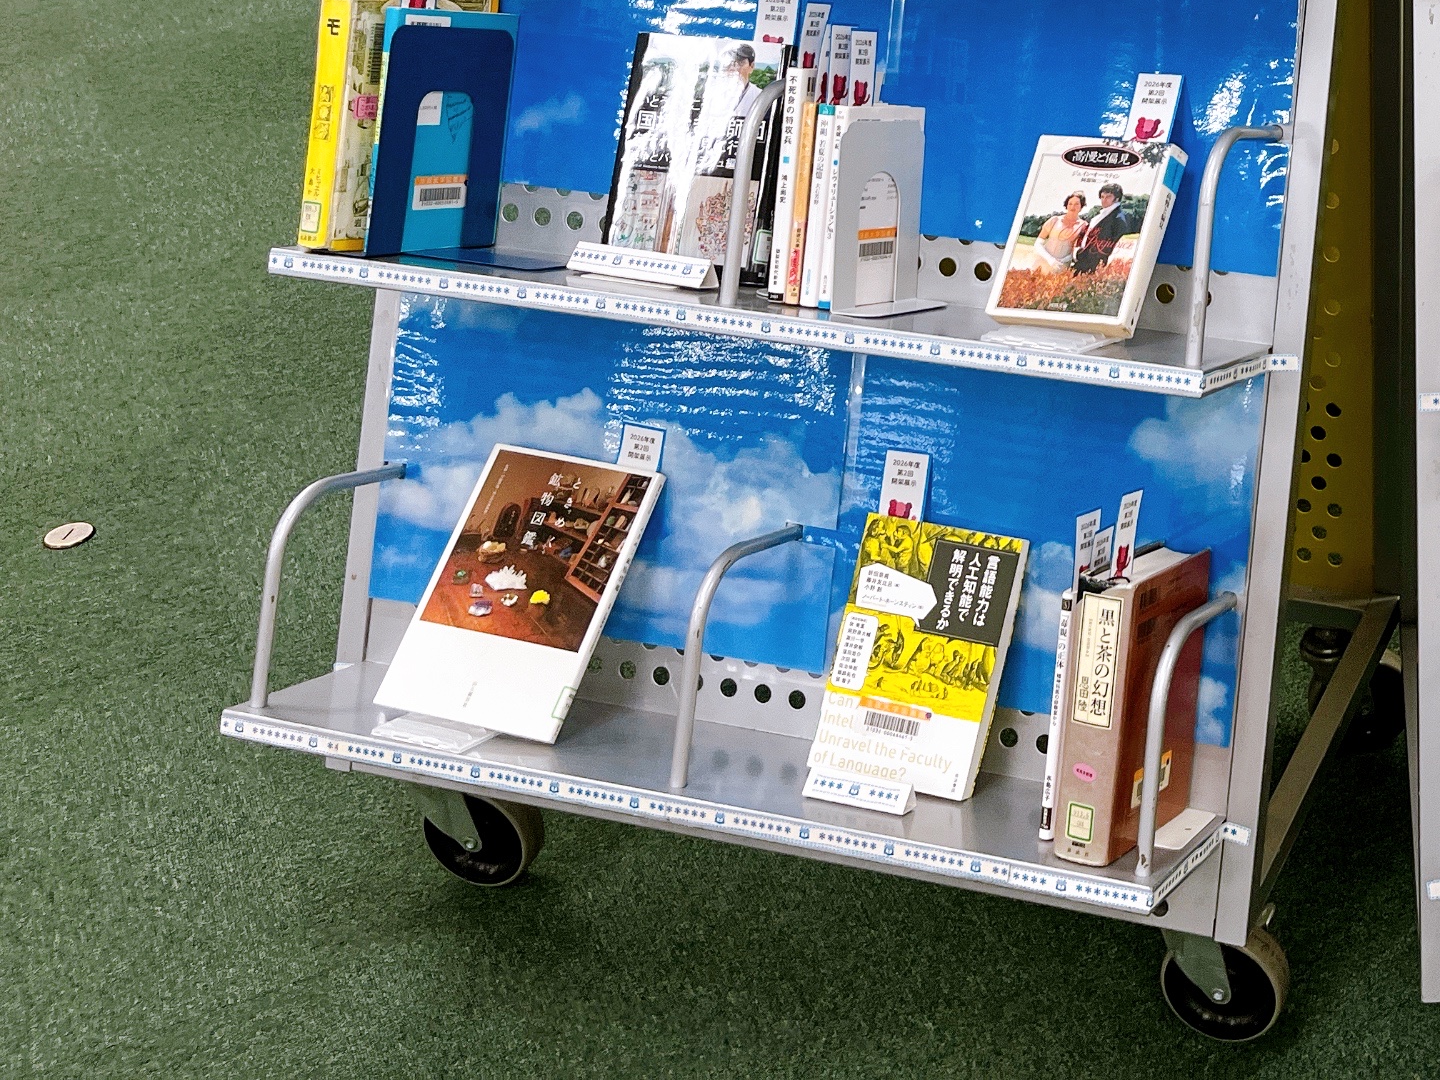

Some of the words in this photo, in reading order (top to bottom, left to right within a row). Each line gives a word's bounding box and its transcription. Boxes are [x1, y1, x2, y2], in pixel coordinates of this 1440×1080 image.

[783, 75, 797, 145] 不死身の特攻兵
[1072, 150, 1131, 166] 高慢と偏見
[521, 472, 564, 550] 鉱物図鑑
[936, 548, 968, 630] 解明できるか
[957, 552, 982, 622] 人工知能で
[973, 555, 1001, 627] 言語能力は
[1078, 676, 1089, 712] 恩田陸
[1090, 607, 1117, 717] 黒と茶の幻想
[829, 692, 853, 708] Can
[814, 750, 828, 763] of
[818, 729, 871, 753] Unravel
[875, 742, 897, 759] the
[900, 747, 952, 774] Faculty
